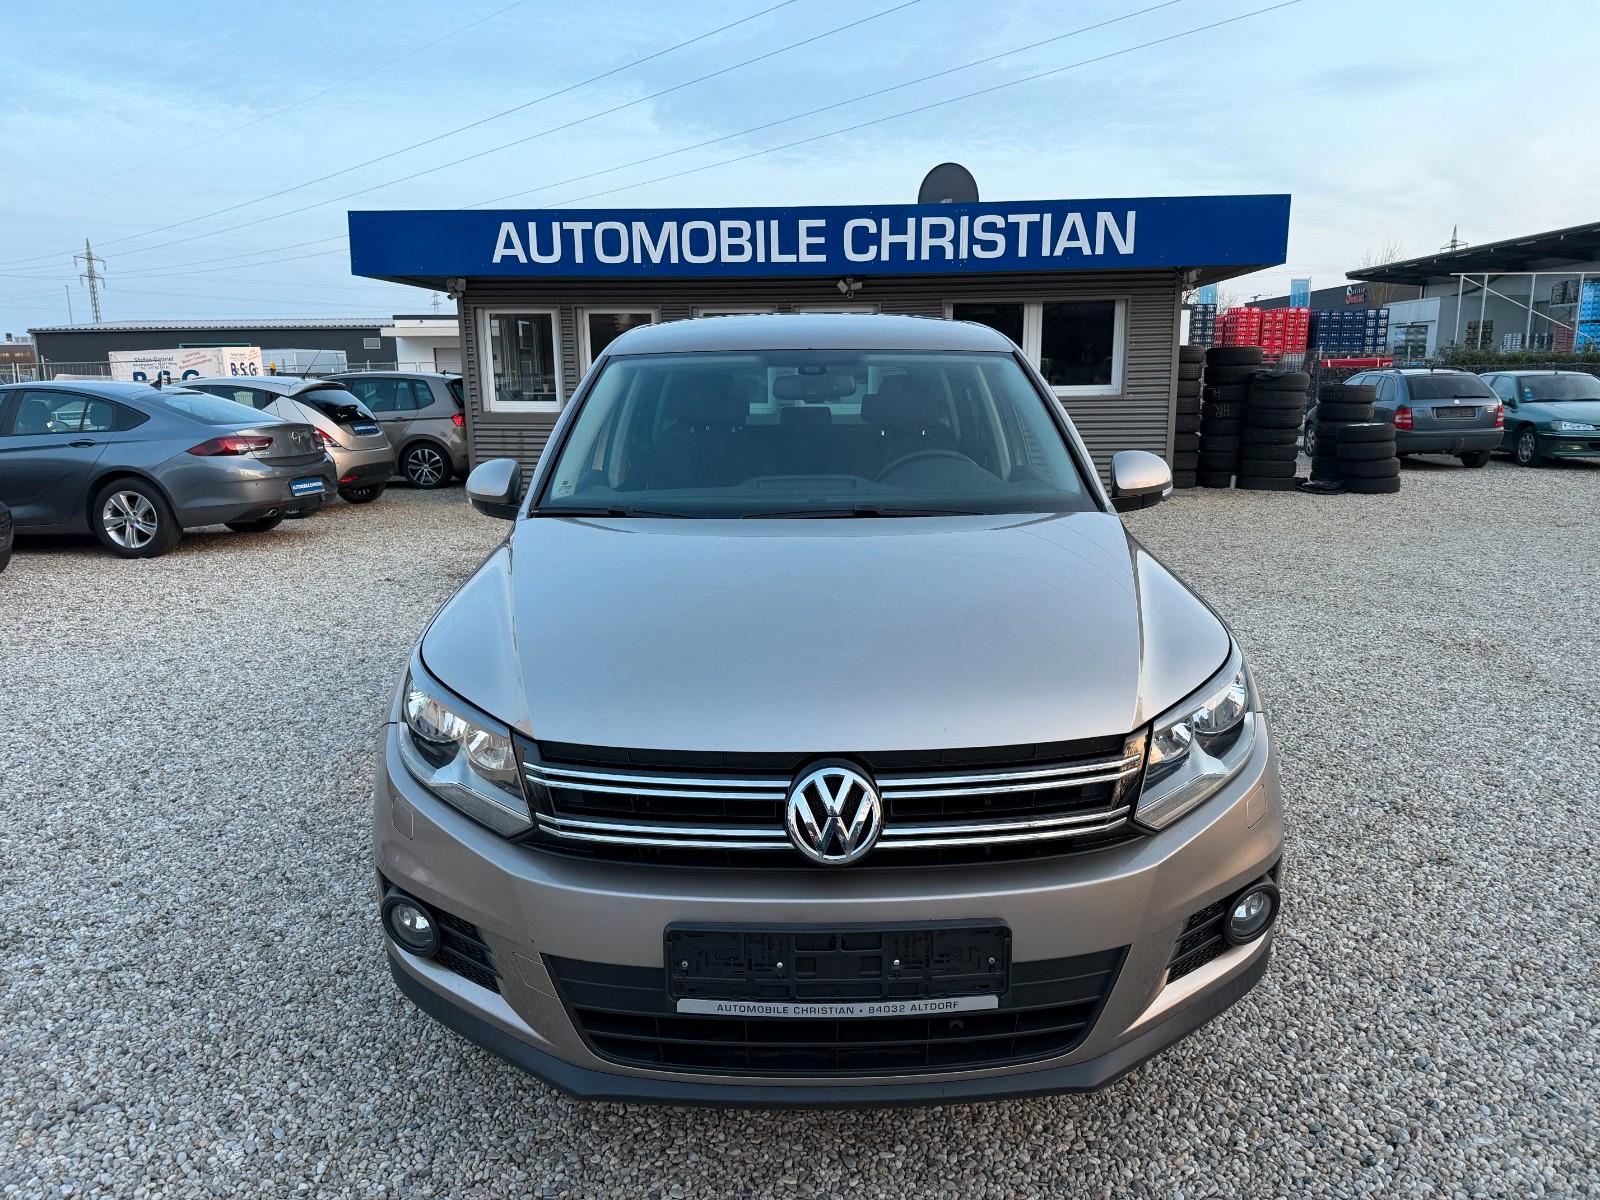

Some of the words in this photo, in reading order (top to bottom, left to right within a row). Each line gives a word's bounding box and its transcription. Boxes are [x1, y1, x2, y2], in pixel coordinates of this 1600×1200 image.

[492, 219, 827, 264] AUTOMOBILE
[843, 210, 1136, 262] CHRISTIAN
[716, 1003, 789, 1014] AUTOMOBILE
[793, 1005, 854, 1015] CHRISTIAN
[868, 1004, 905, 1014] 84032
[910, 1001, 960, 1012] ALTDORF
